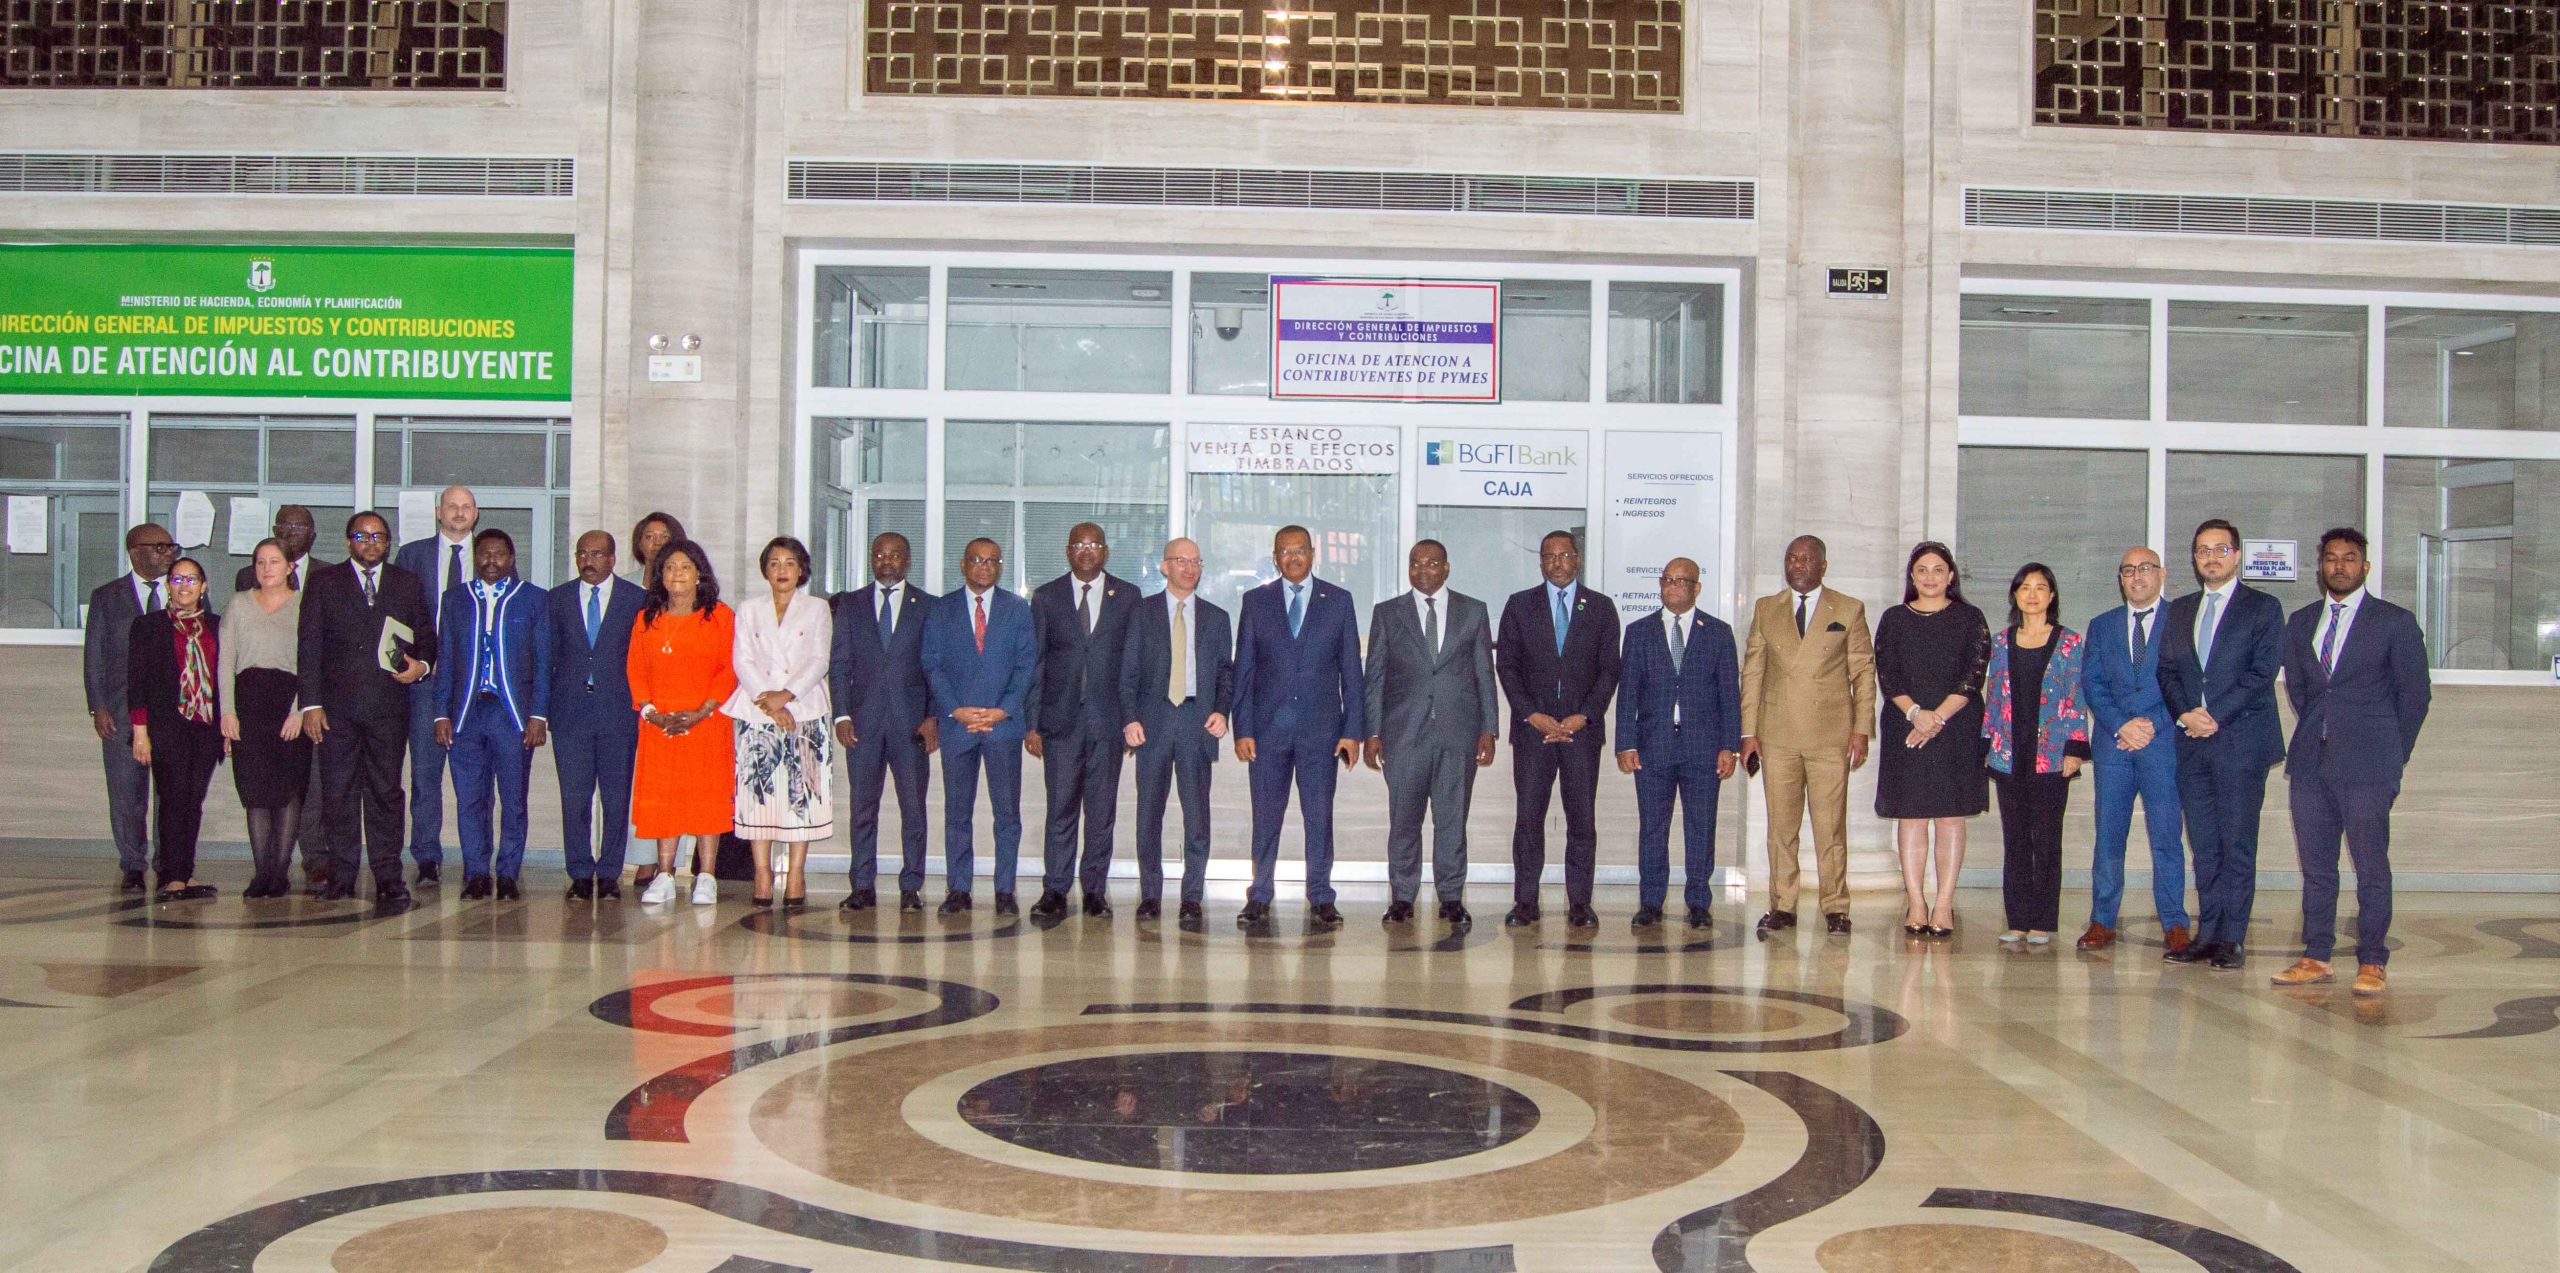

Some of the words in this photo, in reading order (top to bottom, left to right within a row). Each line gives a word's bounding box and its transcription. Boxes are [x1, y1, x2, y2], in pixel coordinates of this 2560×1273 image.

[120, 295, 180, 307] MINISTERIO
[183, 296, 197, 307] DE
[200, 296, 254, 309] HACIENDA,
[257, 294, 312, 308] ECONOMÍA
[315, 297, 322, 308] Y
[324, 296, 402, 309] PLANIFICACIÓN
[0, 310, 89, 334] IRECCIÓN
[94, 315, 178, 334] GENERAL
[184, 316, 209, 335] DE
[214, 316, 324, 336] IMPUESTOS
[329, 317, 342, 336] Y
[346, 317, 515, 339] CONTRIBUCIONES
[1294, 321, 1353, 331] DIRECCIÓN
[1357, 322, 1404, 332] GENERAL
[1406, 323, 1419, 332] DE
[1422, 323, 1478, 333] IMPUESTOS
[1338, 331, 1344, 341] Y
[1348, 332, 1438, 342] CONTRIBUCIONES
[0, 344, 62, 374] CINA
[72, 345, 108, 375] DE
[117, 340, 257, 376] ATENCIÓN
[267, 347, 303, 376] AL
[312, 347, 553, 380] CONTRIBUYENTE
[1295, 353, 1356, 366] OFICINA
[1361, 354, 1380, 366] DE
[1385, 354, 1460, 367] ATENCION
[1462, 355, 1471, 367] A
[1283, 369, 1412, 383] CONTRIBUYENTES
[1416, 370, 1435, 383] DE
[1440, 371, 1488, 384] PYMES
[1249, 427, 1343, 441] ESTANCO
[1190, 441, 1253, 455] VENTA
[1270, 442, 1294, 456] DE
[1310, 443, 1395, 457] EFECTOS
[1237, 457, 1353, 471] TIMBRADOS
[1627, 473, 1668, 481] SERVICIOS
[1669, 473, 1714, 481] OFRECIDOS
[1483, 480, 1533, 497] CAJA
[1623, 497, 1677, 506] REINTEGROS
[1622, 510, 1665, 518] INGRESOS
[1626, 566, 1664, 574] SERVICES
[1621, 604, 1661, 612] VERSEME
